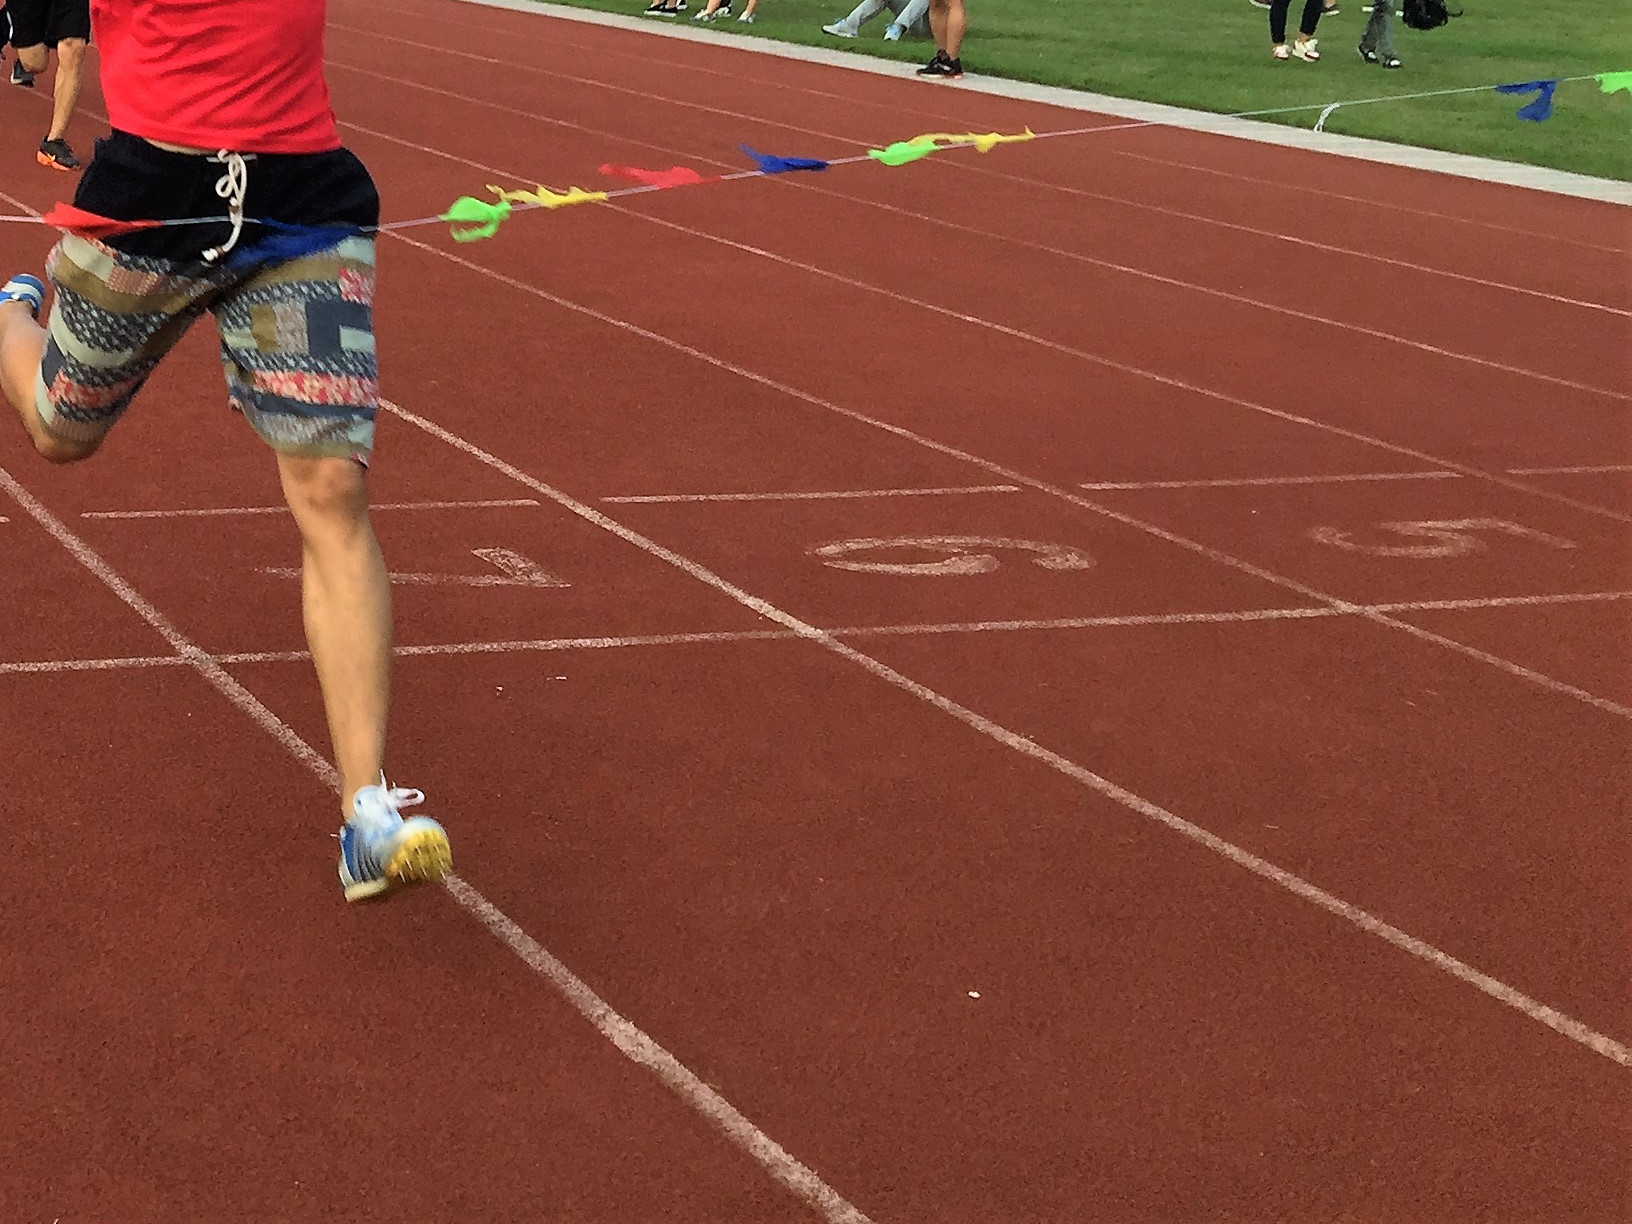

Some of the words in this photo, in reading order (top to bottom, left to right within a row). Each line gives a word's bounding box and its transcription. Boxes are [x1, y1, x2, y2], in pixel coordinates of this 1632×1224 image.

[804, 534, 1098, 577] 6
[1312, 517, 1579, 559] 5
[253, 546, 572, 589] 7
